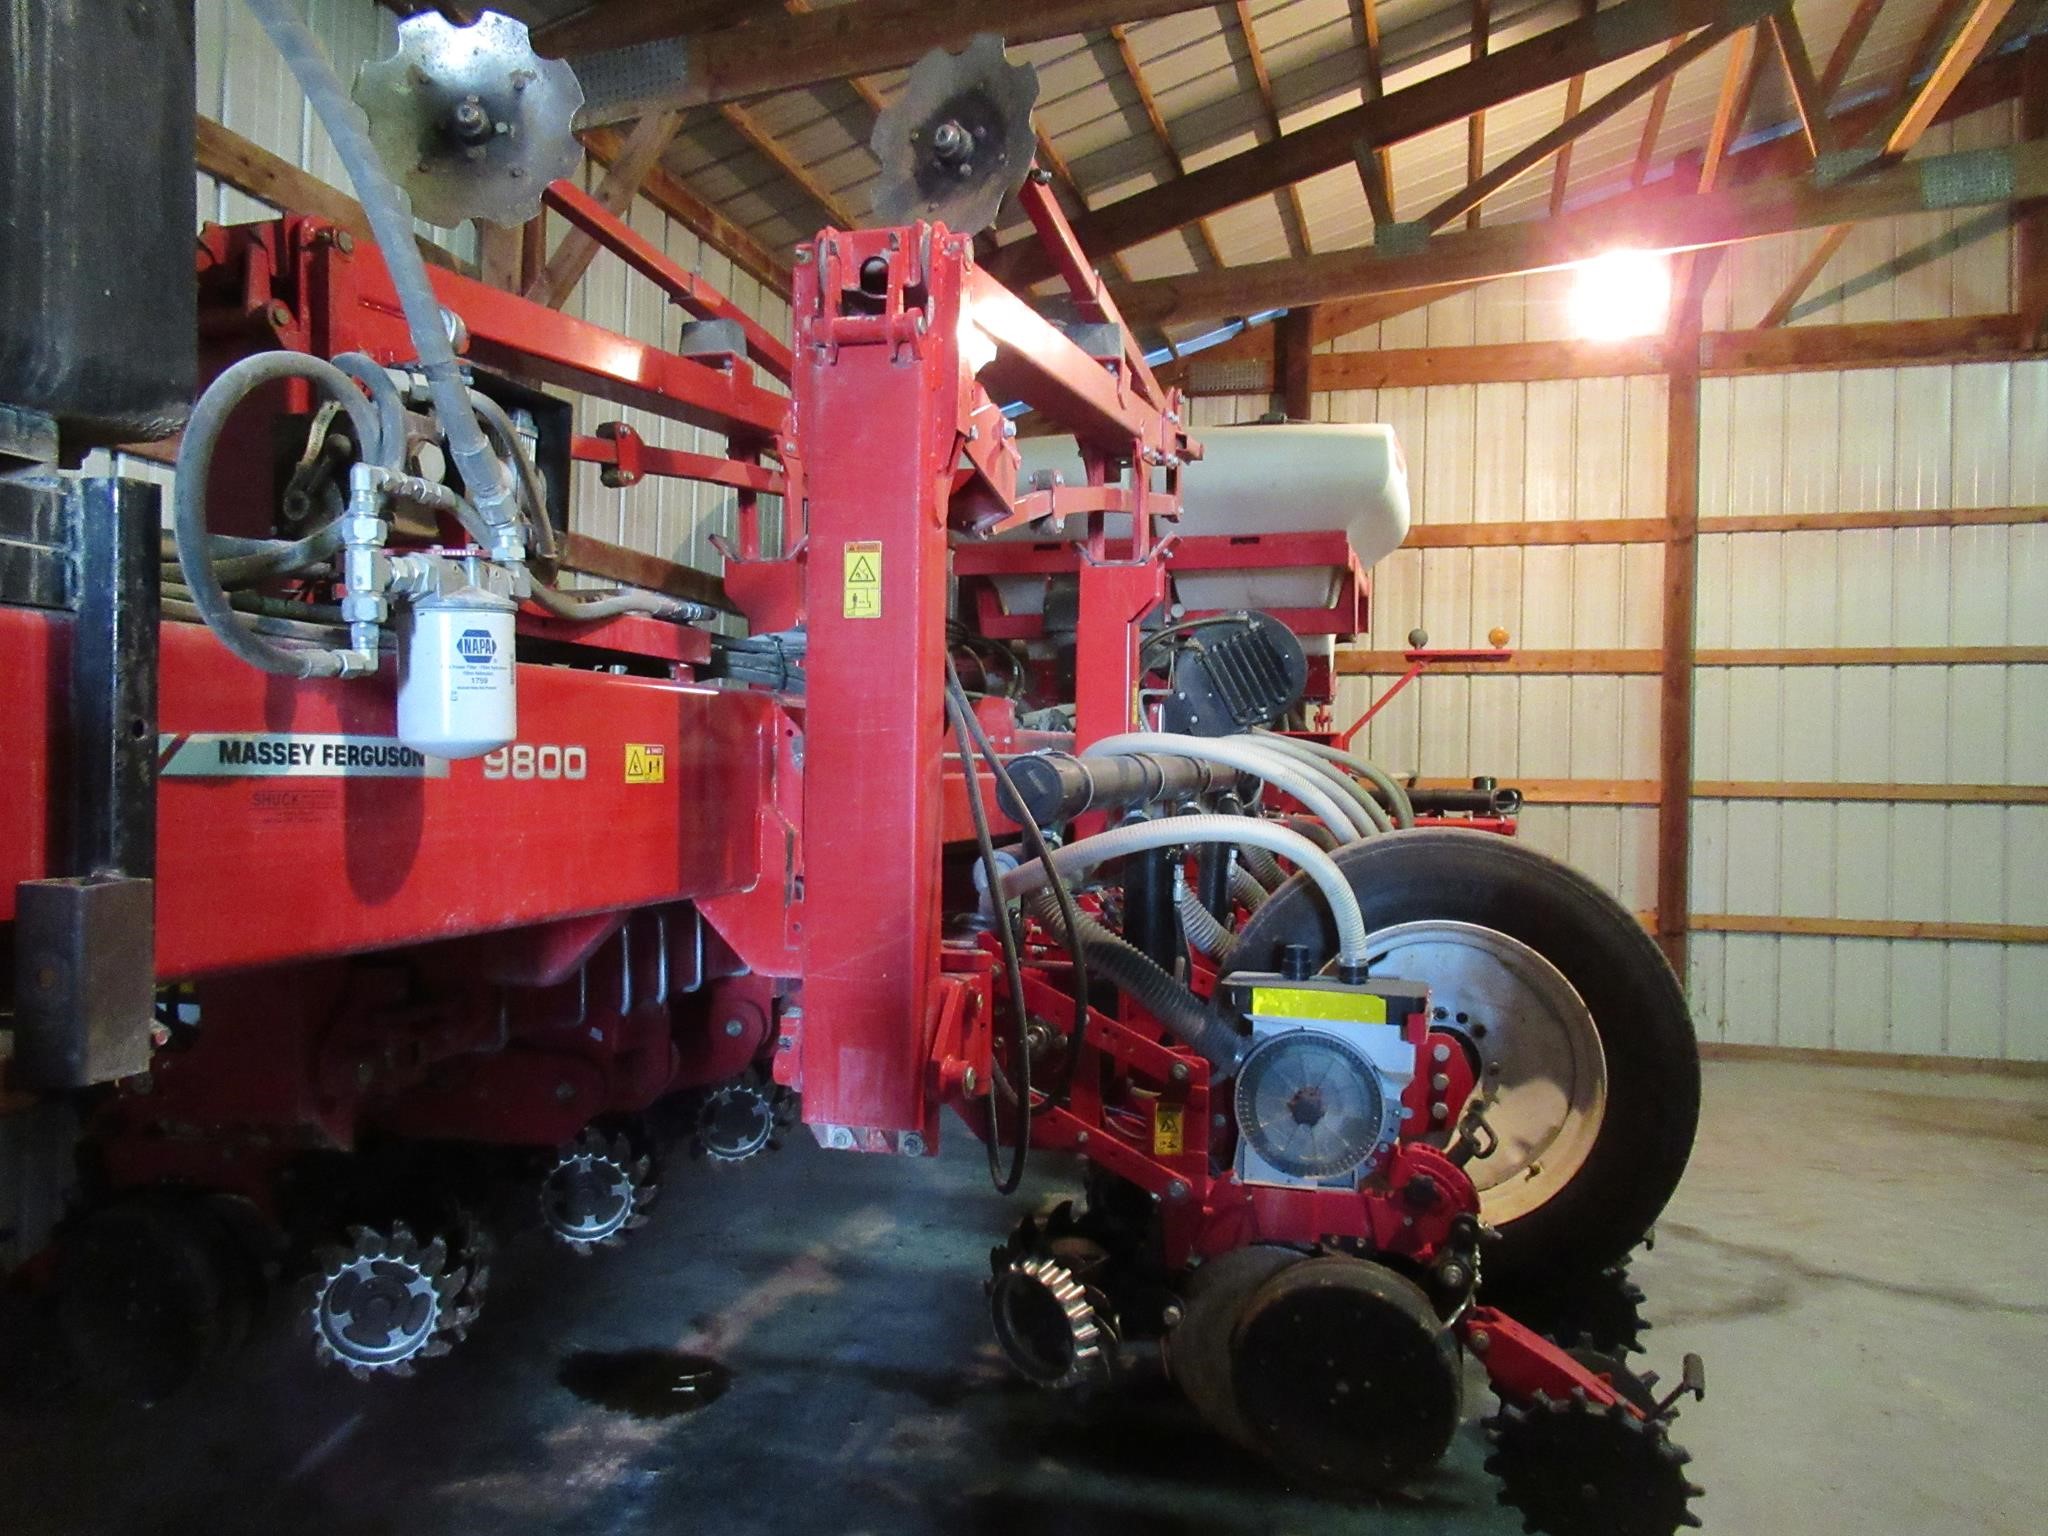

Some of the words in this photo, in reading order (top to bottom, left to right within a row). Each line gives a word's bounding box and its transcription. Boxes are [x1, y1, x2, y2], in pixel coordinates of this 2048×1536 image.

[464, 639, 492, 654] NAPA
[219, 740, 314, 765] MASSEY
[323, 744, 425, 767] FERGUSON
[484, 745, 586, 779] 9800
